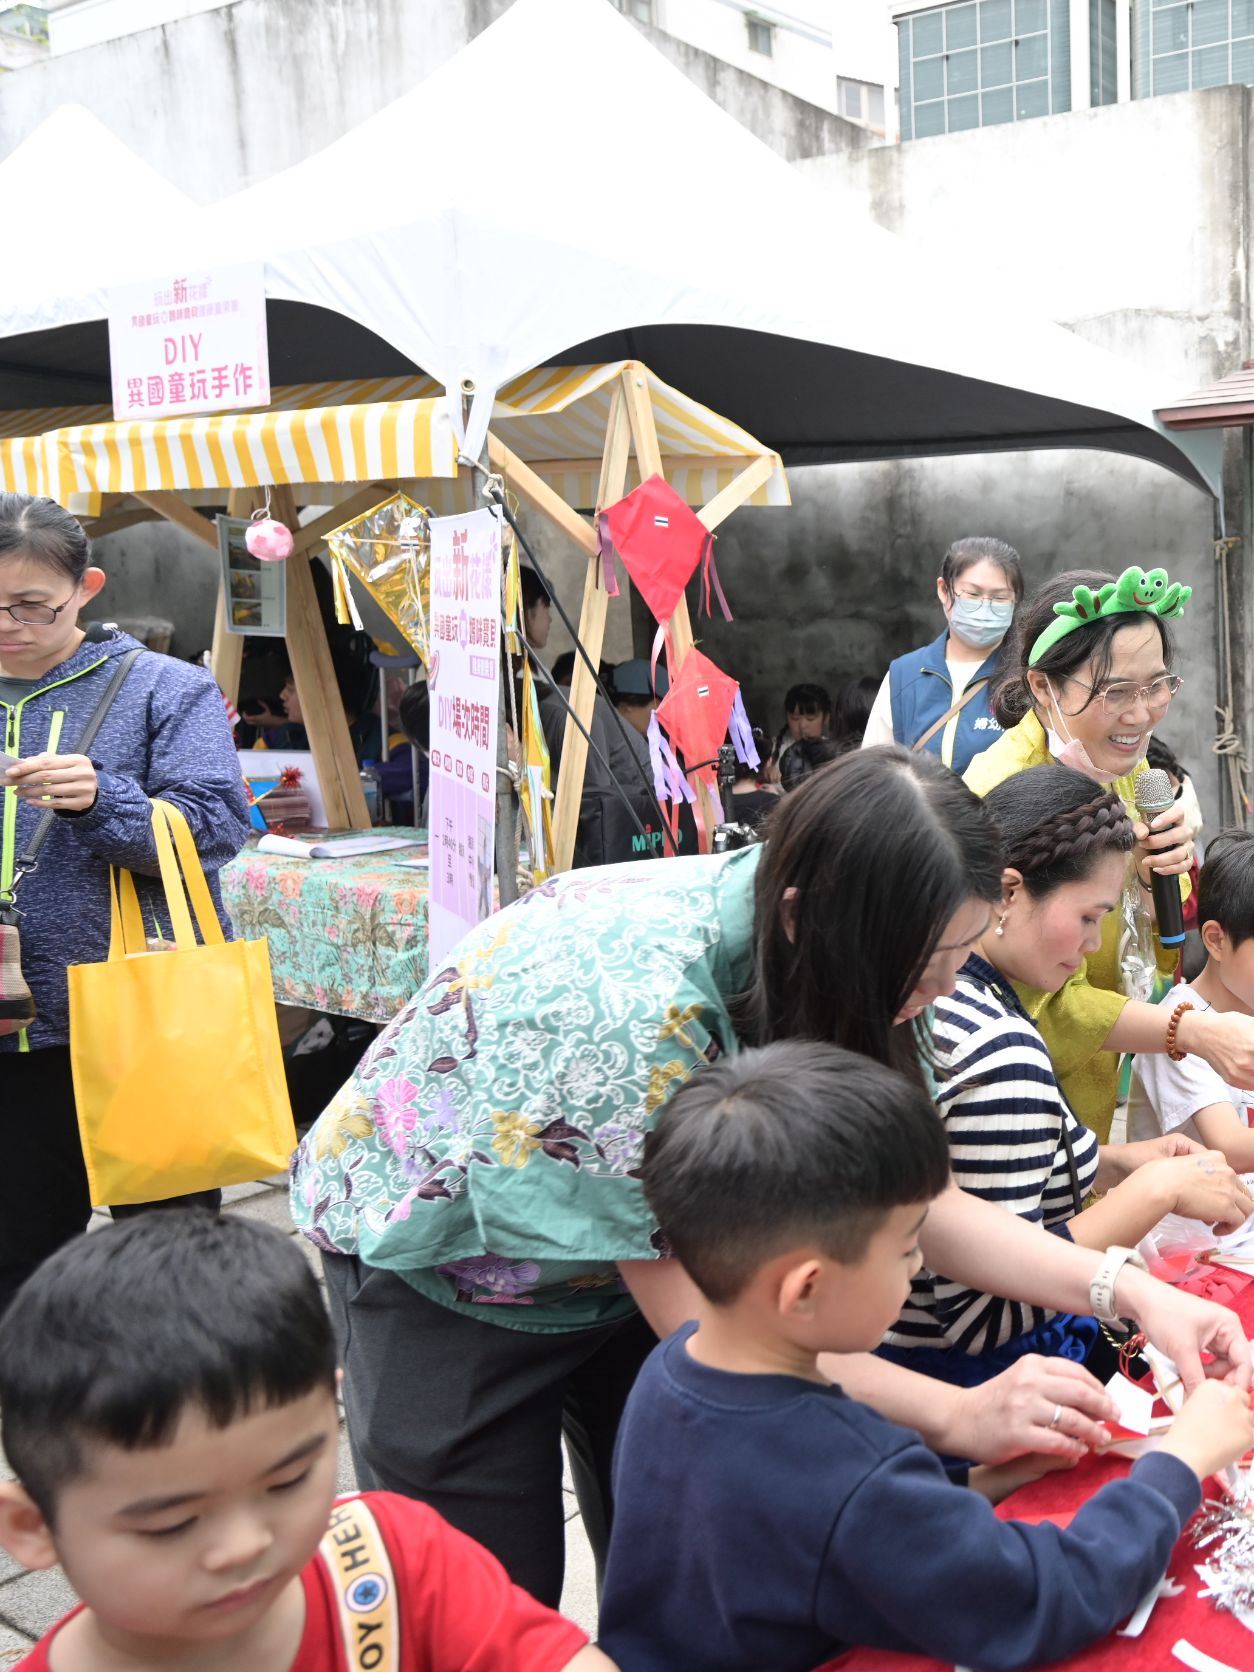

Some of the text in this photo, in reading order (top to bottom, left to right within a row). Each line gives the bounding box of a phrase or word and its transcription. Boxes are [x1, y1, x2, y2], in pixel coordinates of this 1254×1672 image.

[164, 333, 202, 366] DIY
[127, 362, 253, 409] 異國童玩手作
[973, 716, 1004, 732] 婦幼
[632, 823, 683, 852] MiP
